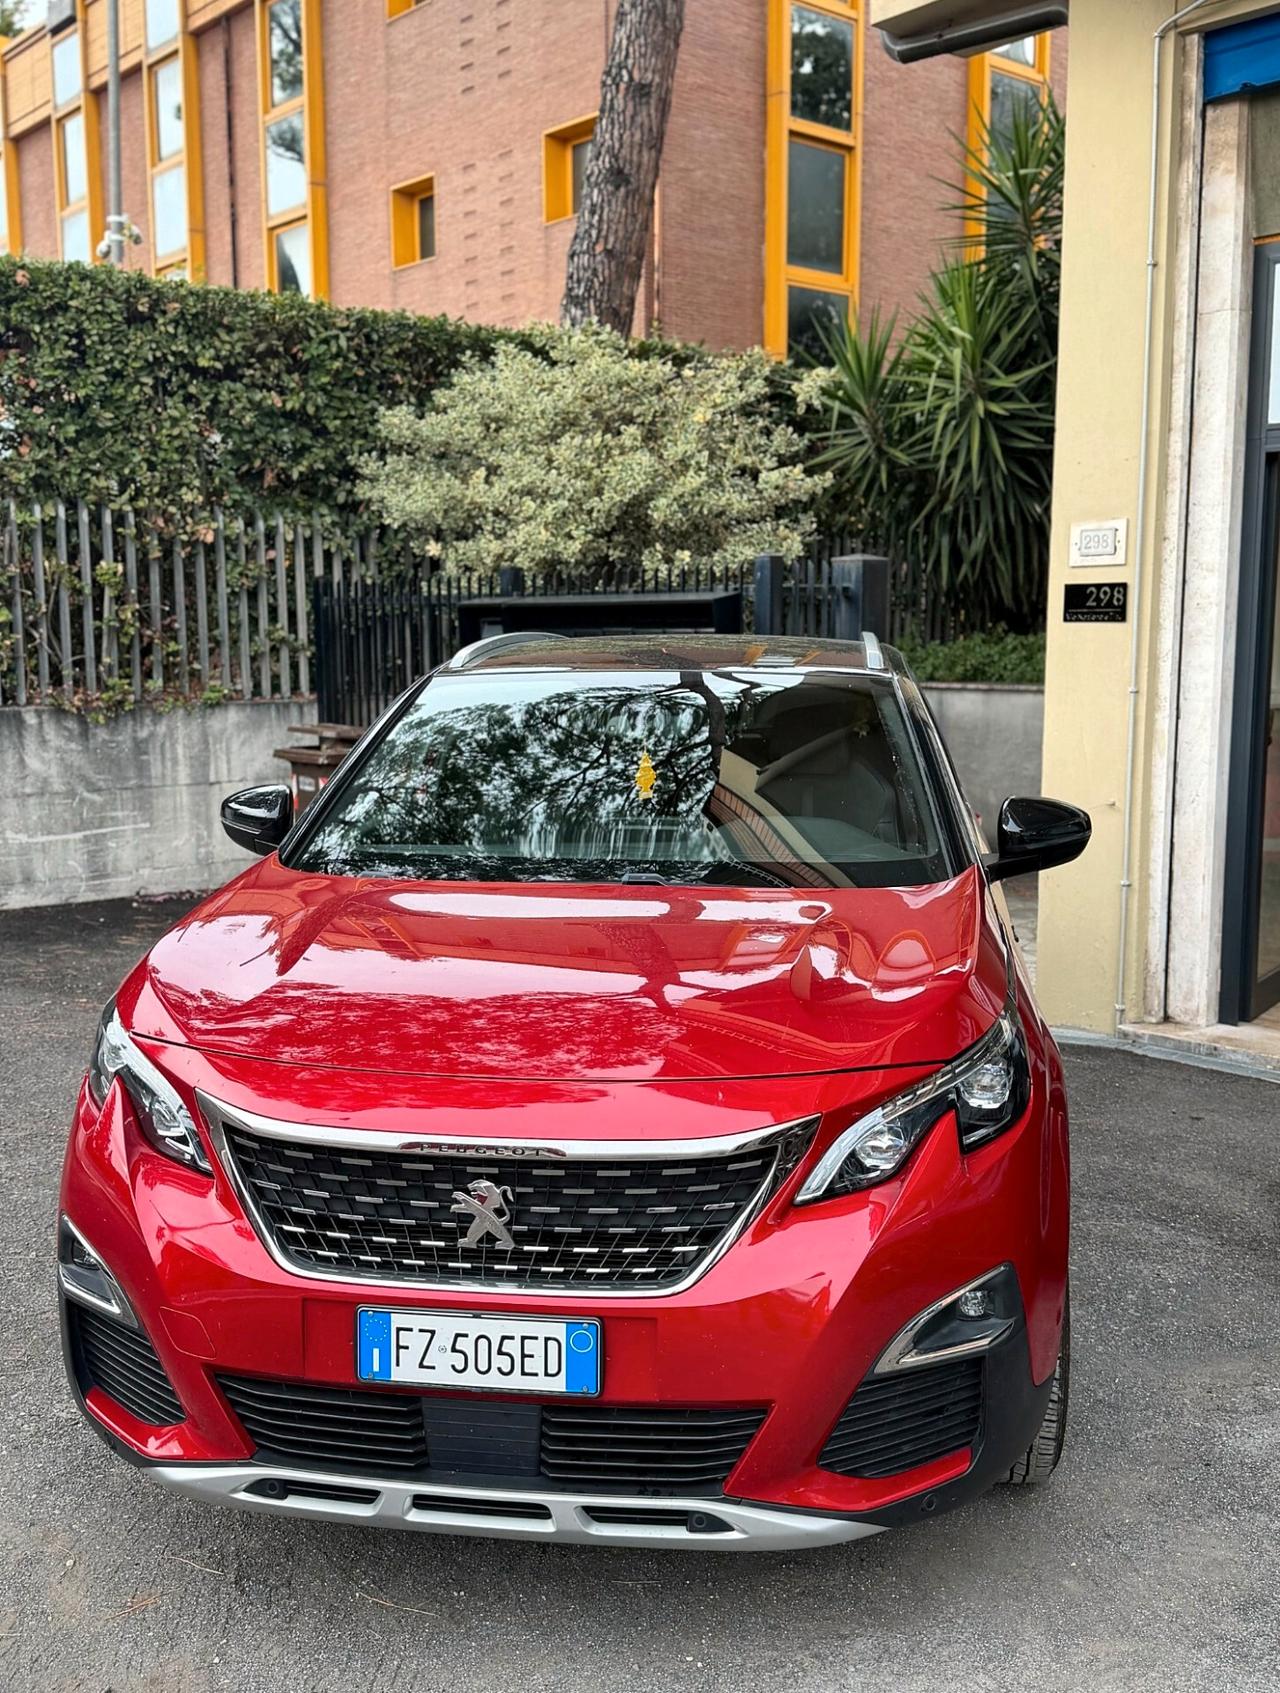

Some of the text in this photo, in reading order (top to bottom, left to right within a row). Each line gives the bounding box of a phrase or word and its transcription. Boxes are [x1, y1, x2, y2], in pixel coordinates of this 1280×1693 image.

[1083, 533, 1110, 549] 298
[1086, 586, 1124, 607] 298
[419, 1143, 541, 1157] PEUGEOT
